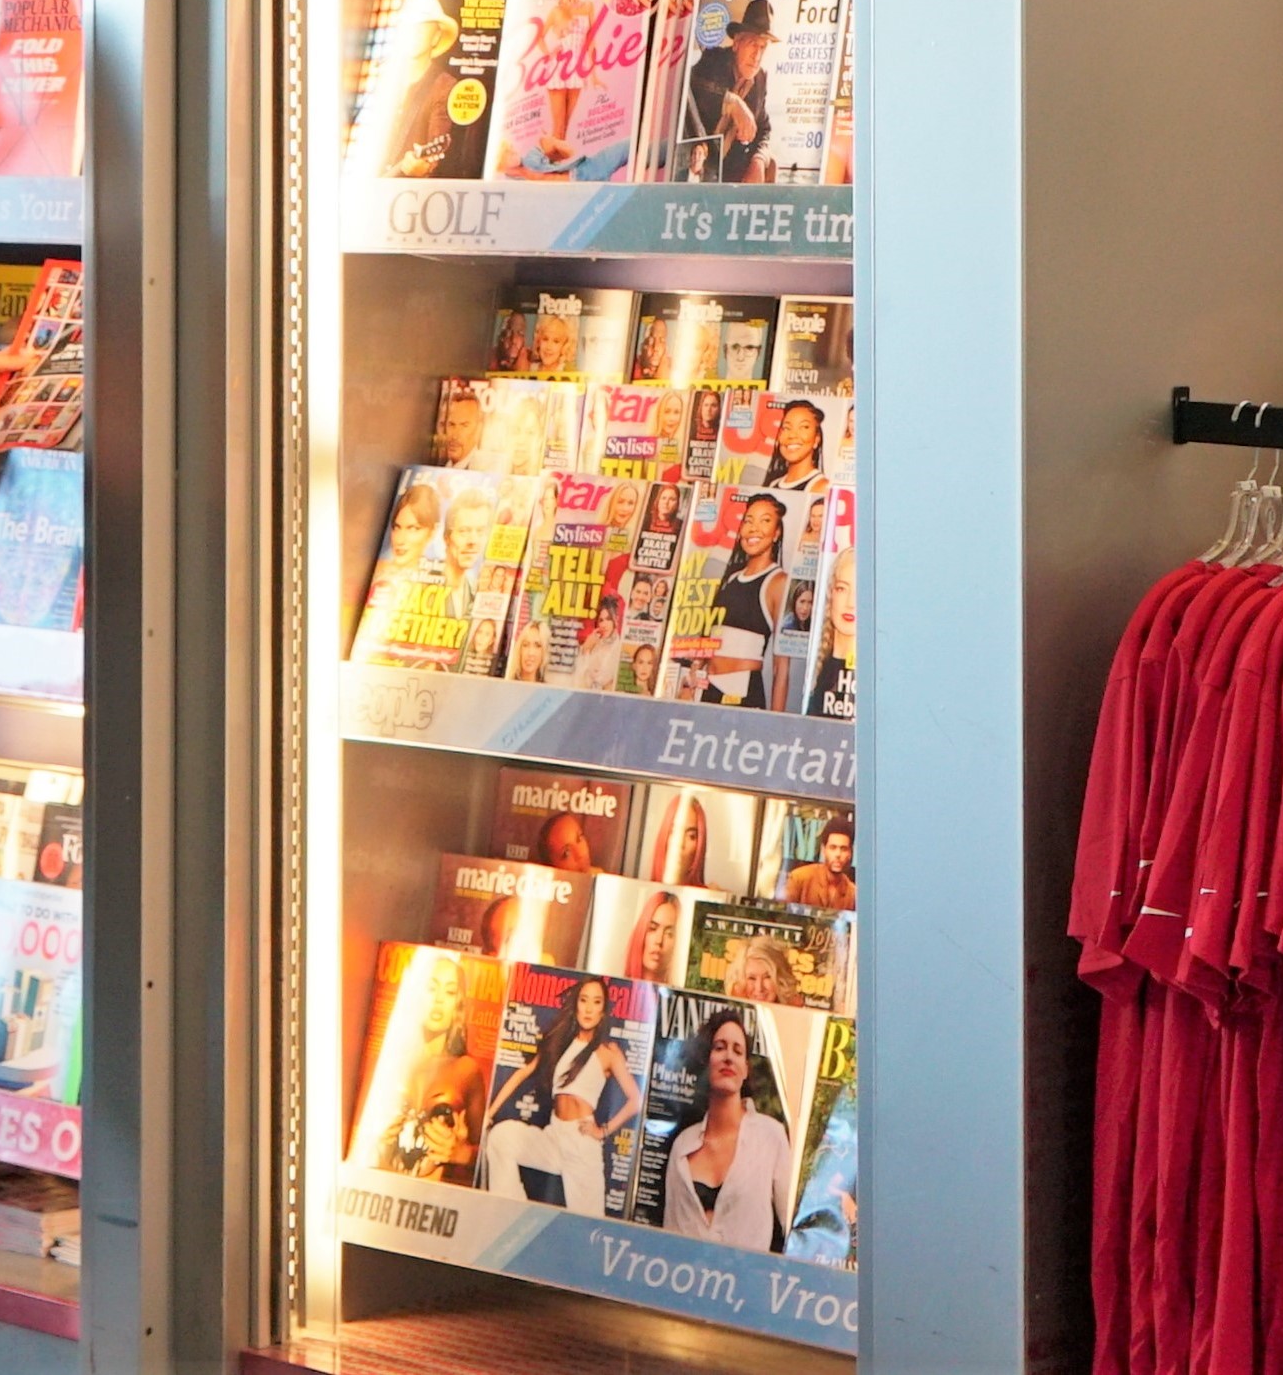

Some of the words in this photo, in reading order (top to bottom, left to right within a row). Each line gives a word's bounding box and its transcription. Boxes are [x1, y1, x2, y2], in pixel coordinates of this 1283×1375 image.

[10, 37, 65, 56] FOLD
[786, 31, 837, 46] AMERICA'S
[12, 56, 59, 74] THIS
[788, 46, 834, 61] GREATEST
[775, 62, 804, 75] MOVIE
[806, 61, 833, 75] HERO
[805, 130, 824, 149] 80
[20, 192, 74, 222] Your
[389, 189, 506, 236] GOLF
[660, 203, 713, 241] It's
[724, 203, 794, 242] TEE
[537, 292, 583, 316] People
[785, 311, 826, 334] People
[782, 369, 819, 384] ueen
[606, 436, 656, 458] Stylists
[555, 524, 604, 546] Stylists
[642, 539, 671, 551] BRAVE
[548, 544, 606, 584] TELL
[636, 557, 668, 569] BATTLE
[637, 548, 671, 561] CANCER
[541, 583, 602, 619] ALL!
[674, 577, 721, 607] BEST
[357, 677, 435, 737] eople
[512, 782, 569, 812] marie
[569, 786, 618, 819] claire
[455, 865, 515, 896] marie
[704, 919, 803, 942] SWIMSUIT
[469, 1007, 500, 1027] Latto
[652, 1061, 698, 1086] Phoebe
[394, 1195, 460, 1239] TREND
